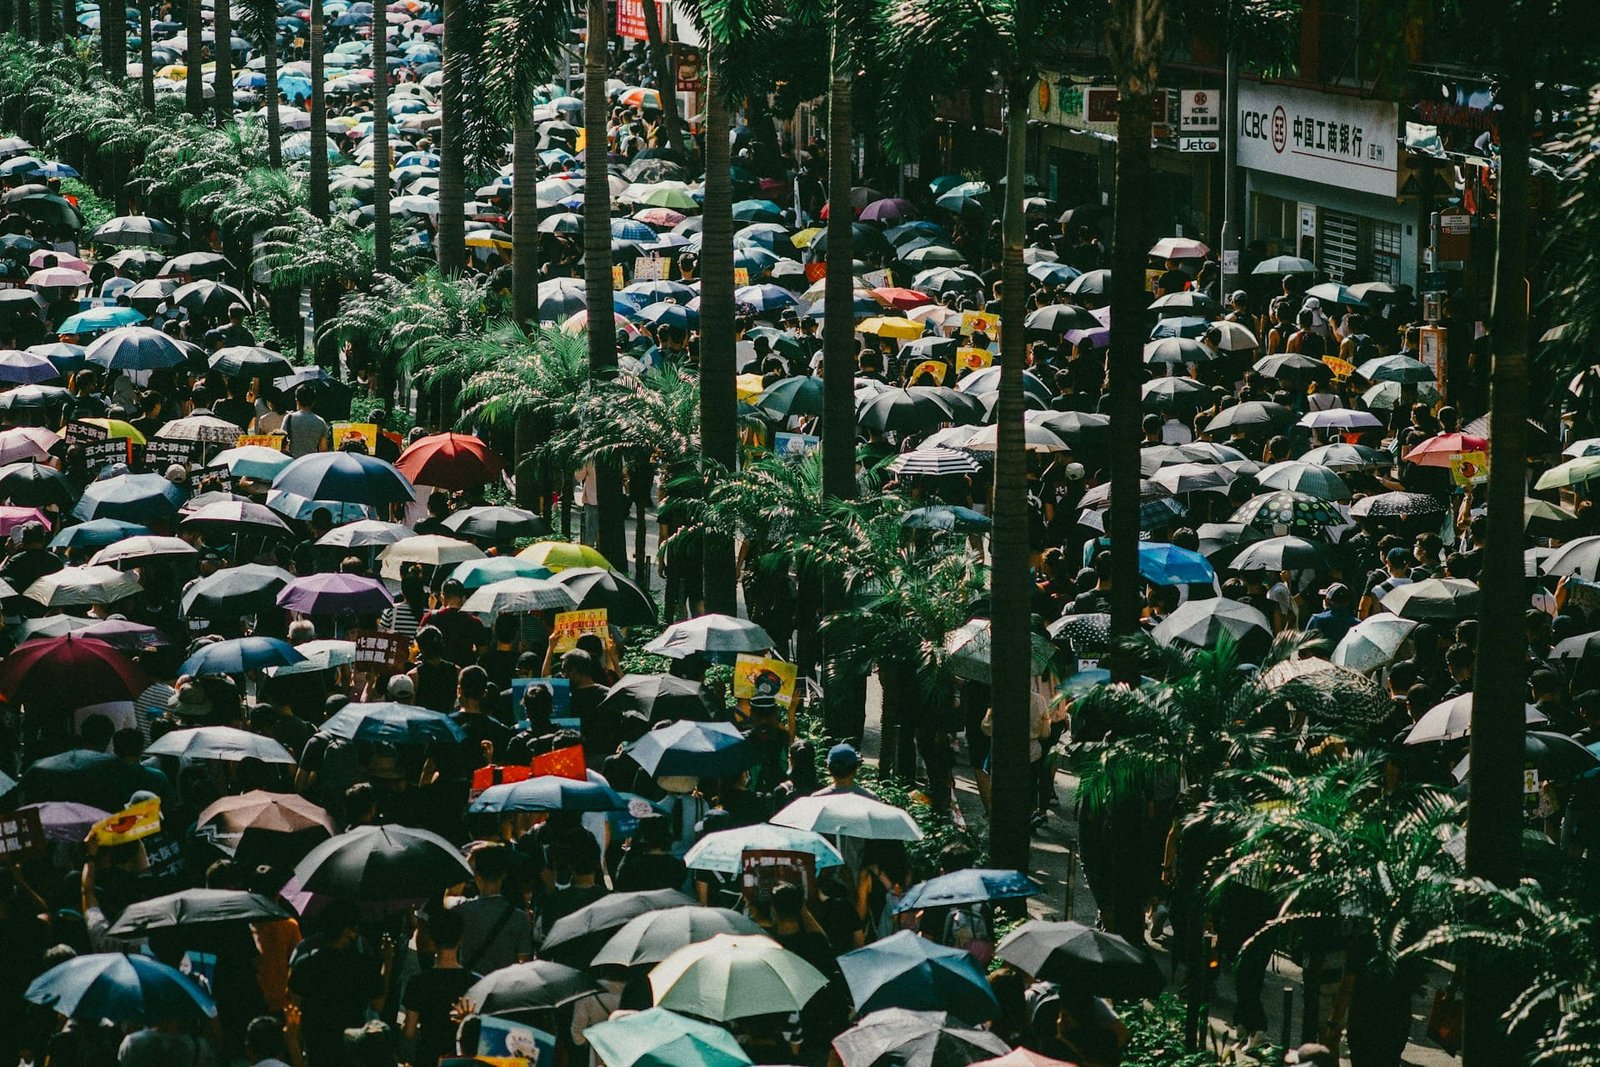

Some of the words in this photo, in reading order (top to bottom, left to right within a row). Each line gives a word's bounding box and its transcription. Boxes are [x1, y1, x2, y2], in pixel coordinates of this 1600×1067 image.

[1241, 110, 1268, 140] ICBC
[1293, 115, 1362, 158] 中国工商银行
[67, 423, 106, 441] 五大訴求
[85, 441, 127, 457] 五大訴求
[146, 441, 191, 454] 五大訴求
